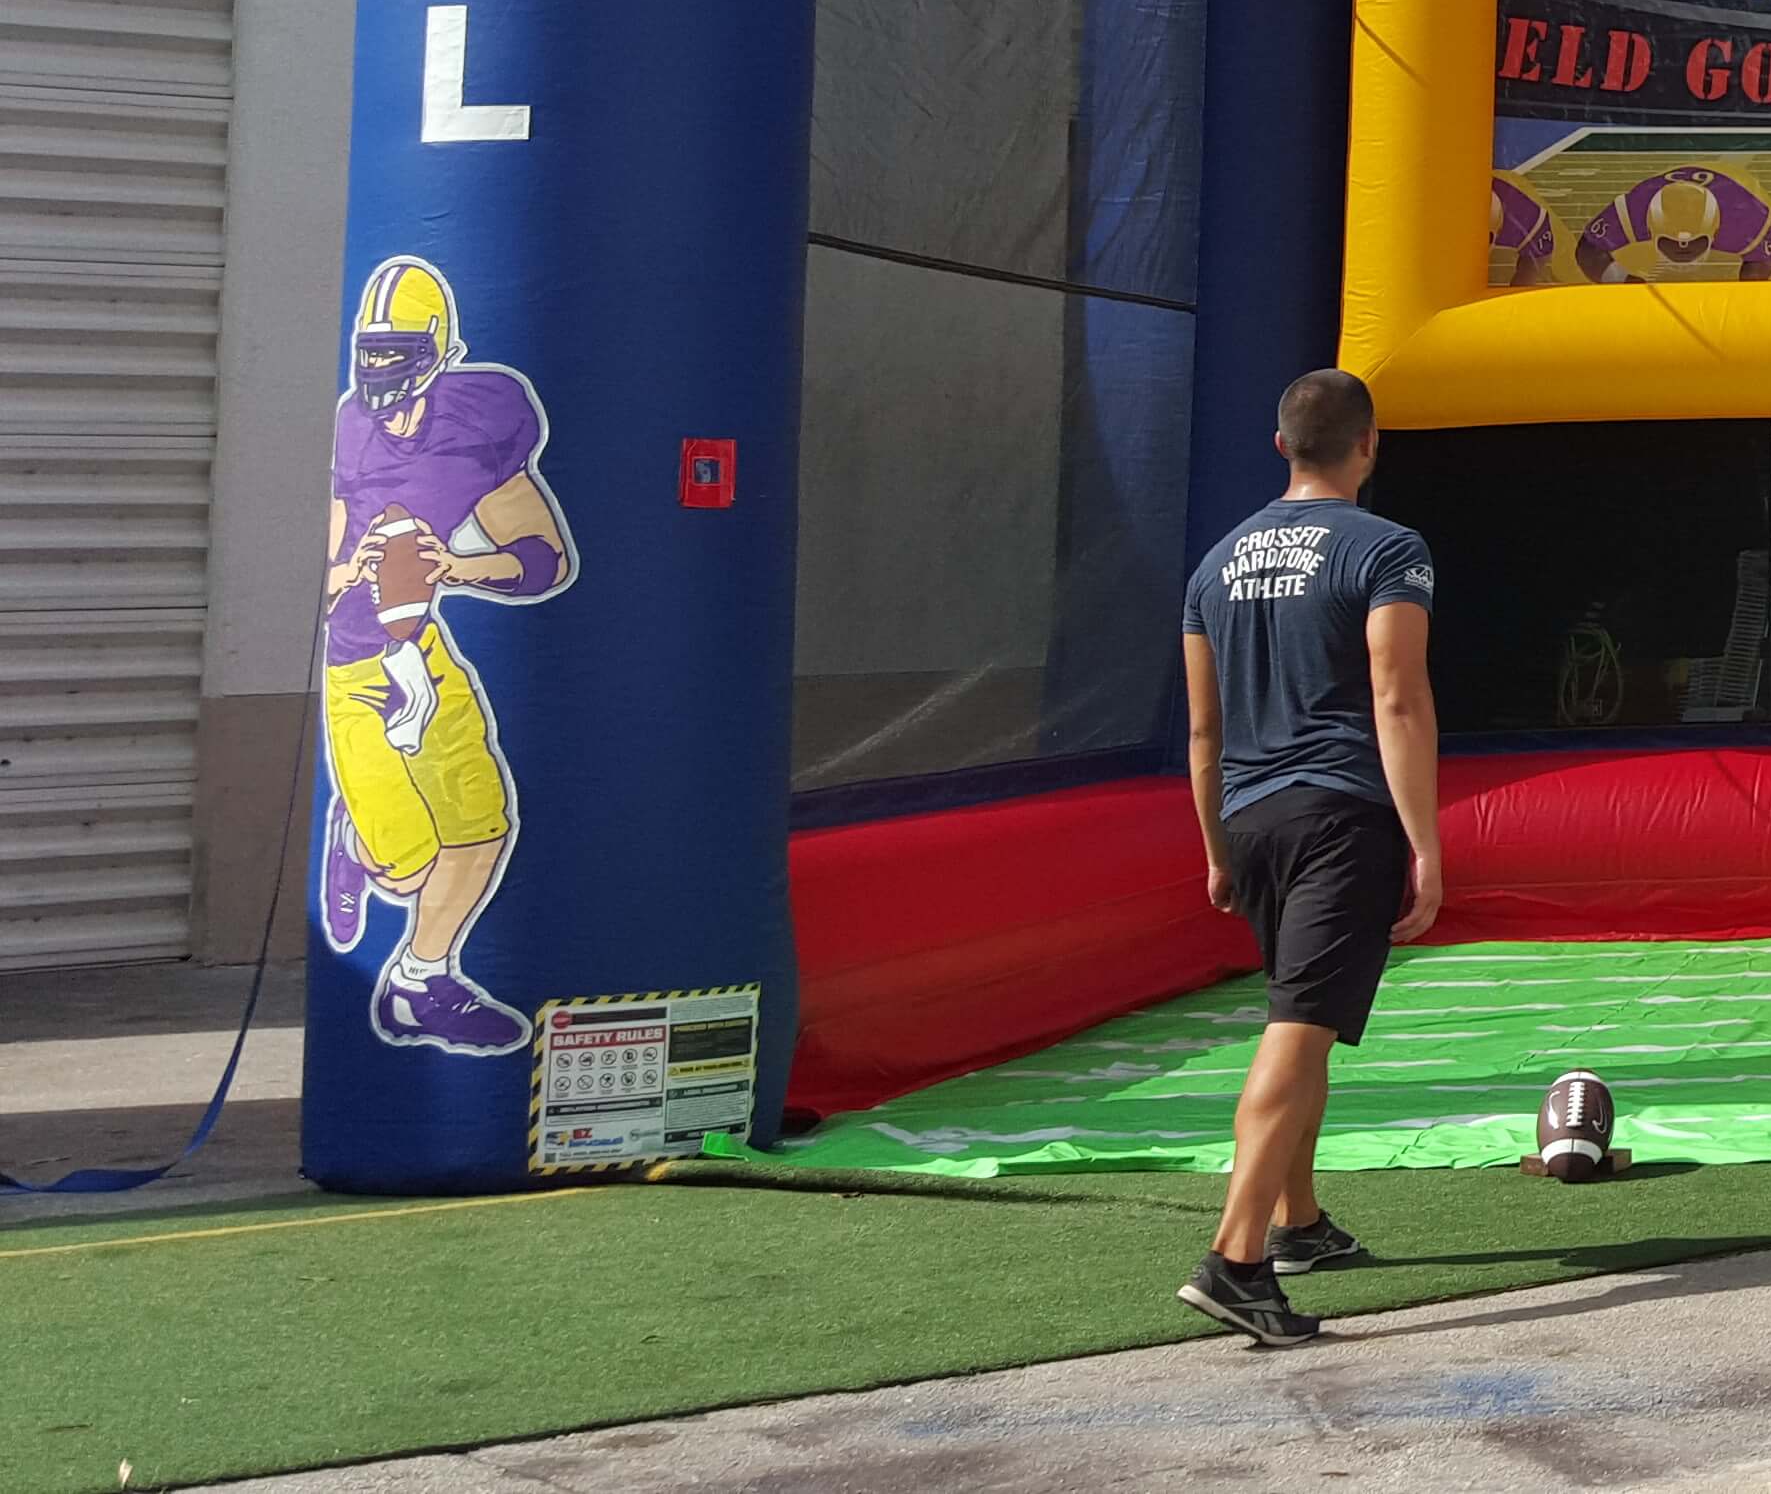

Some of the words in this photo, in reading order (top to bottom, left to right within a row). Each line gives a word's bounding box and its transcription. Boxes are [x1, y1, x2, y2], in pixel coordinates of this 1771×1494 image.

[1497, 17, 1654, 93] ELD
[1234, 526, 1330, 557] CROSSFIT
[1222, 547, 1325, 585] HARDCORE
[1228, 574, 1307, 601] ATHLETE
[552, 1031, 612, 1047] SAFETY
[615, 1027, 664, 1042] RULES
